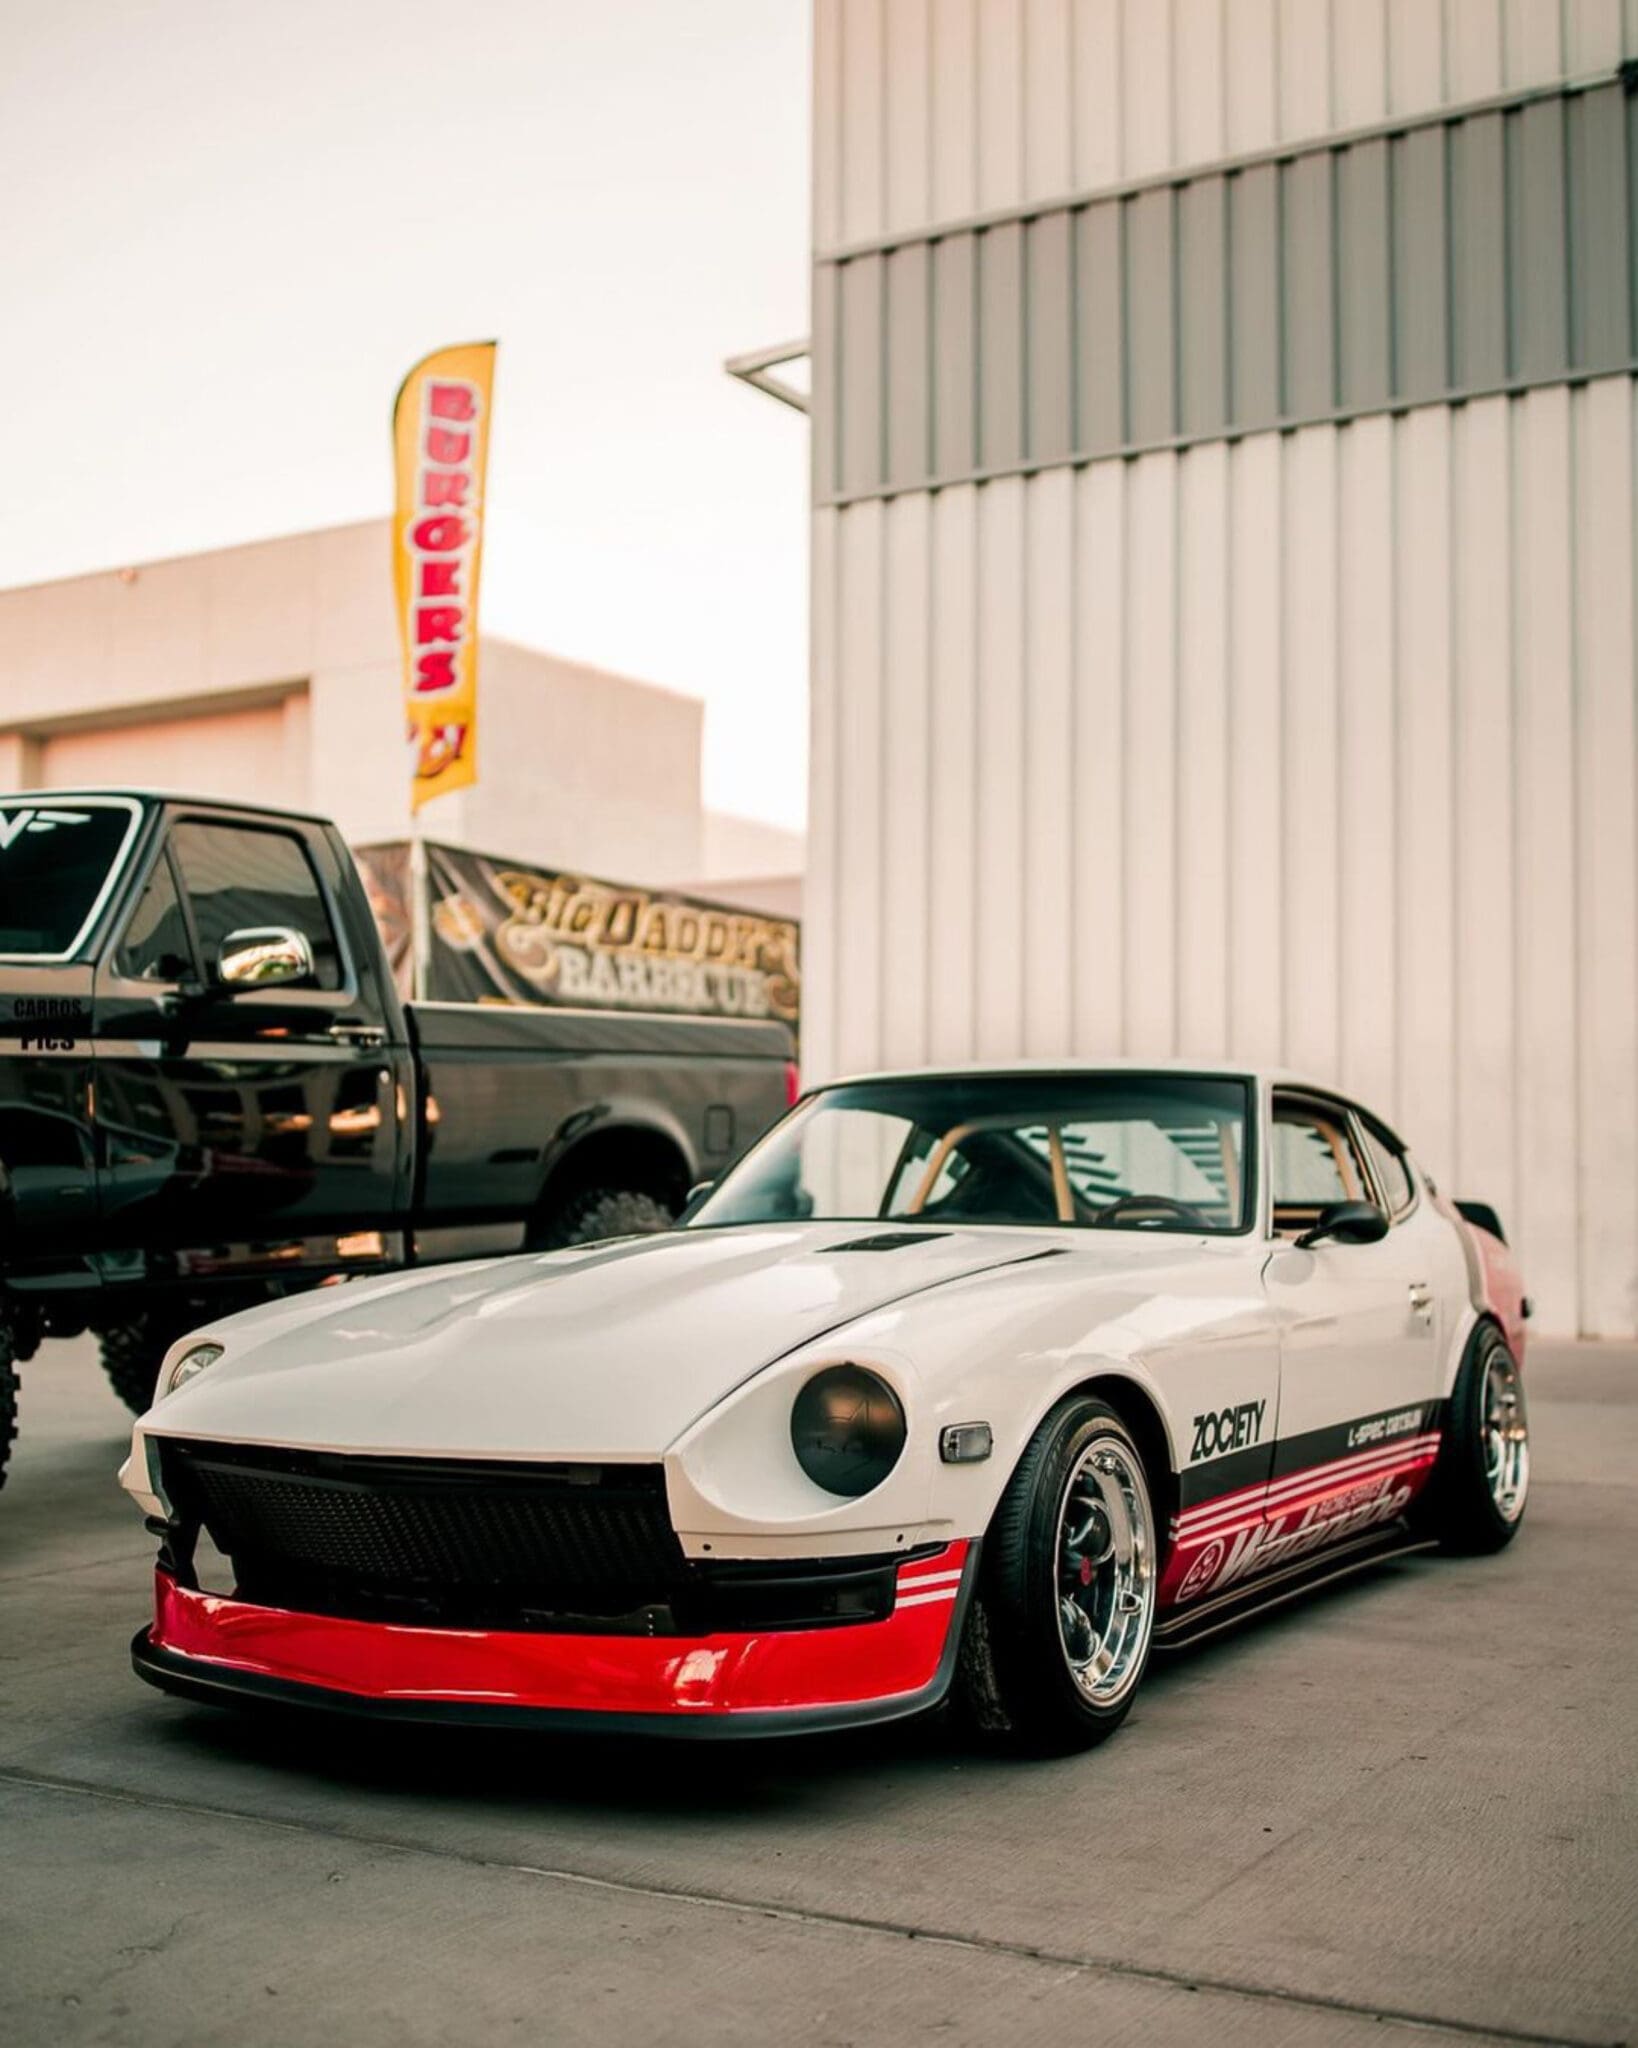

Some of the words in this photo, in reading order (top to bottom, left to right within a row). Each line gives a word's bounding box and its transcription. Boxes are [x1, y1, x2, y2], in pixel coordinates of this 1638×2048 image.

[410, 384, 477, 694] BURGERS
[13, 997, 81, 1018] CARROS
[1190, 1399, 1266, 1462] ZOCIETY
